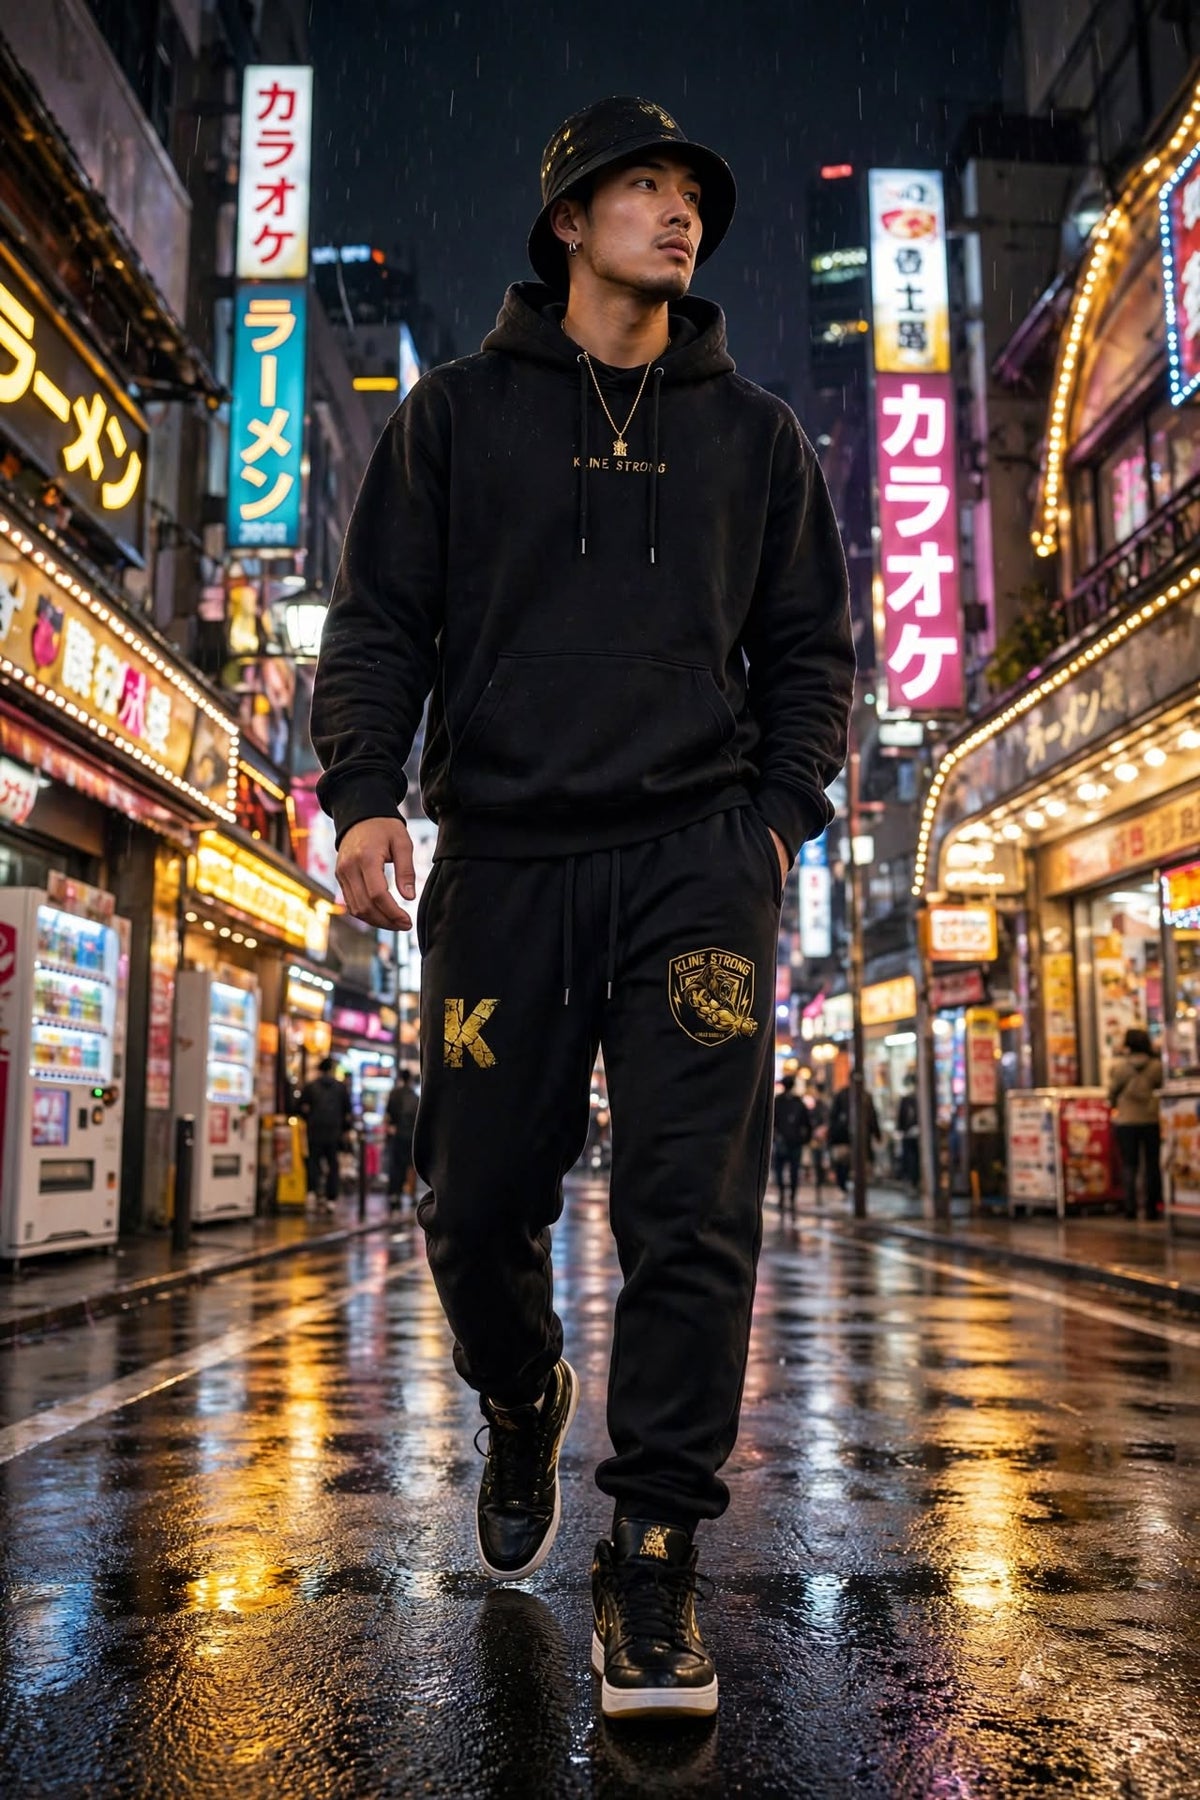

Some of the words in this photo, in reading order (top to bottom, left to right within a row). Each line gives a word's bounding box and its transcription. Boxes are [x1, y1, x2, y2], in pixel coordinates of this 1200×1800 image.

[253, 81, 296, 264] カラオケ
[239, 299, 297, 521] ラーメン
[881, 383, 958, 701] カラオケ
[443, 998, 501, 1068] K
[674, 953, 706, 974] KLINE
[710, 953, 751, 976] STRONG
